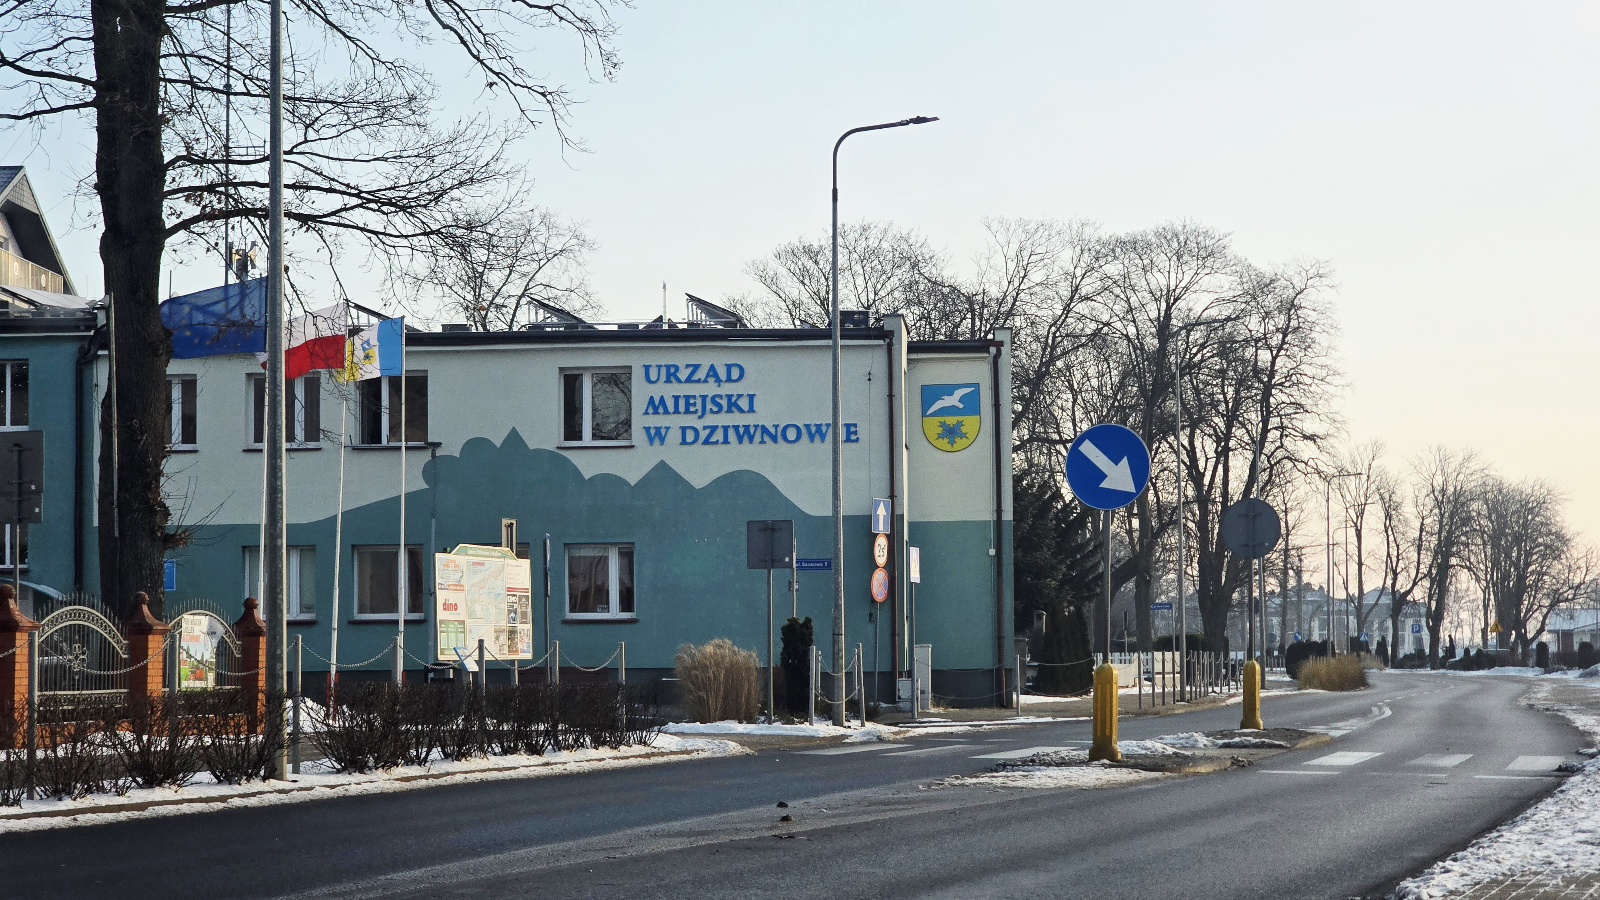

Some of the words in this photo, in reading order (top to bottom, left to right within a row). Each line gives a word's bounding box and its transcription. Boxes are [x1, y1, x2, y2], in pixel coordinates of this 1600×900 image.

[643, 363, 745, 387] URZĄD
[642, 394, 756, 419] MIEJSKI
[642, 426, 671, 446] W
[679, 423, 860, 446] DZIWNOWE
[443, 599, 458, 611] dino
